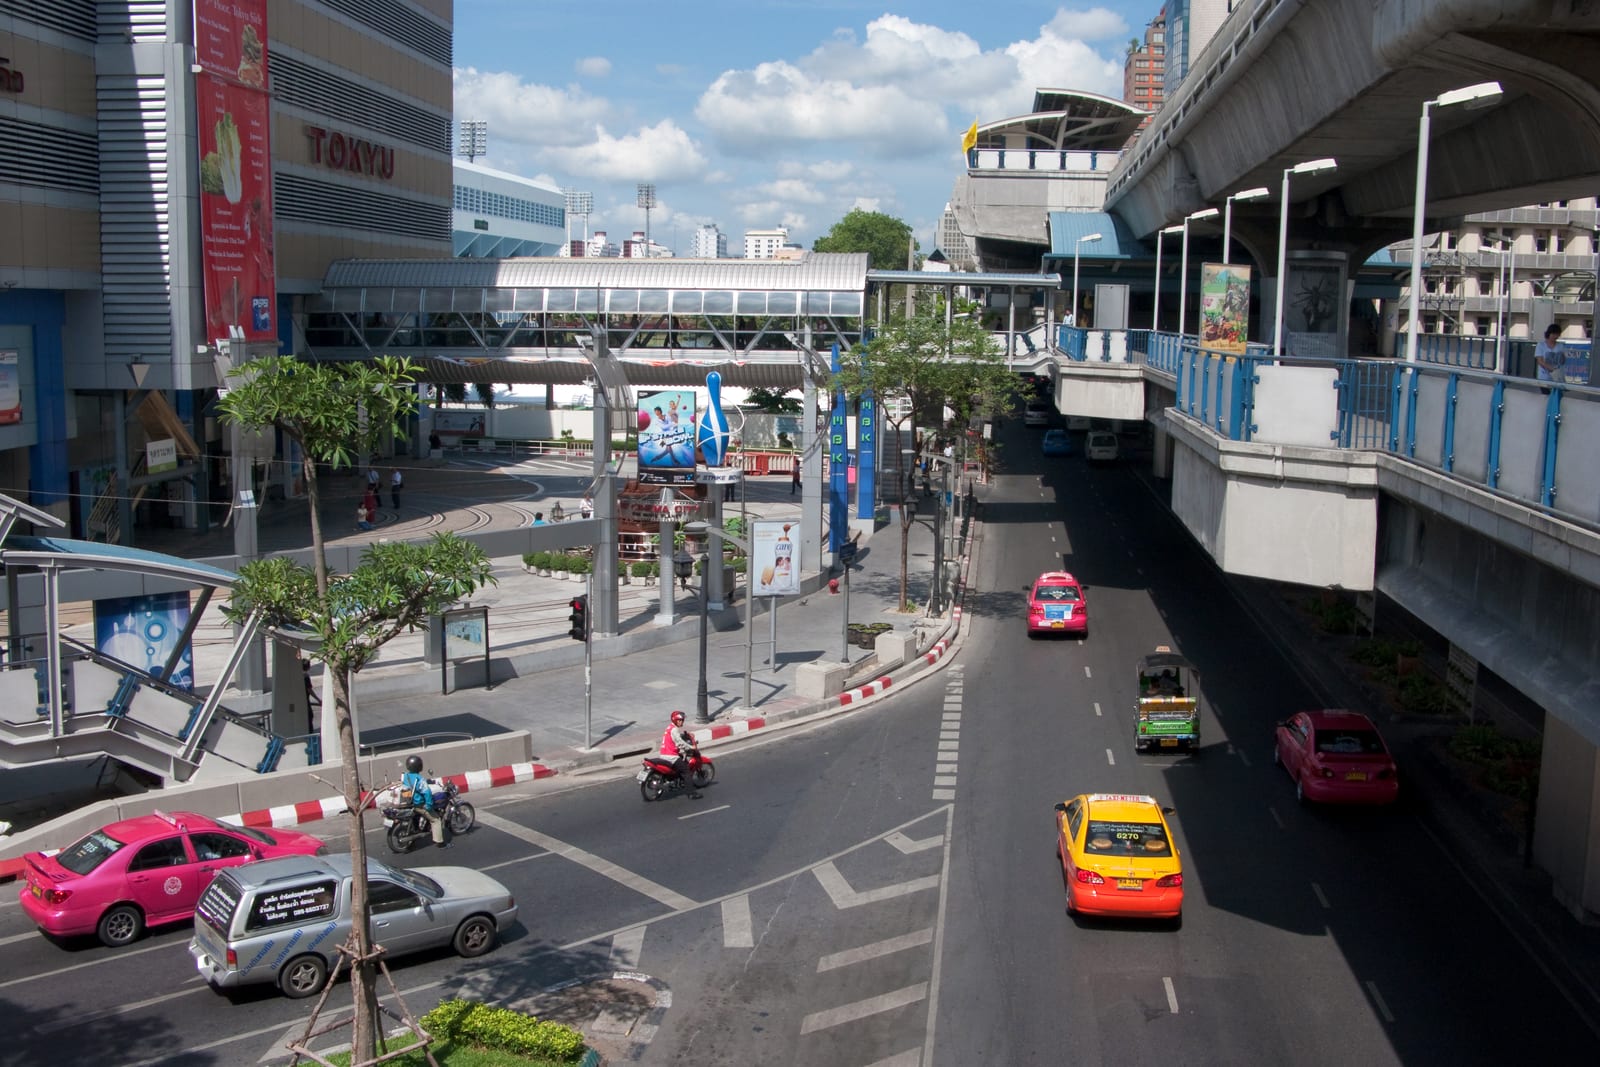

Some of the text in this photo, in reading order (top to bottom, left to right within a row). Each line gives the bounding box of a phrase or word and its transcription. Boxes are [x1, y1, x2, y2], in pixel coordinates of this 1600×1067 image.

[306, 125, 395, 180] TOKYU
[631, 503, 670, 513] CINEMA
[674, 503, 701, 513] CITY
